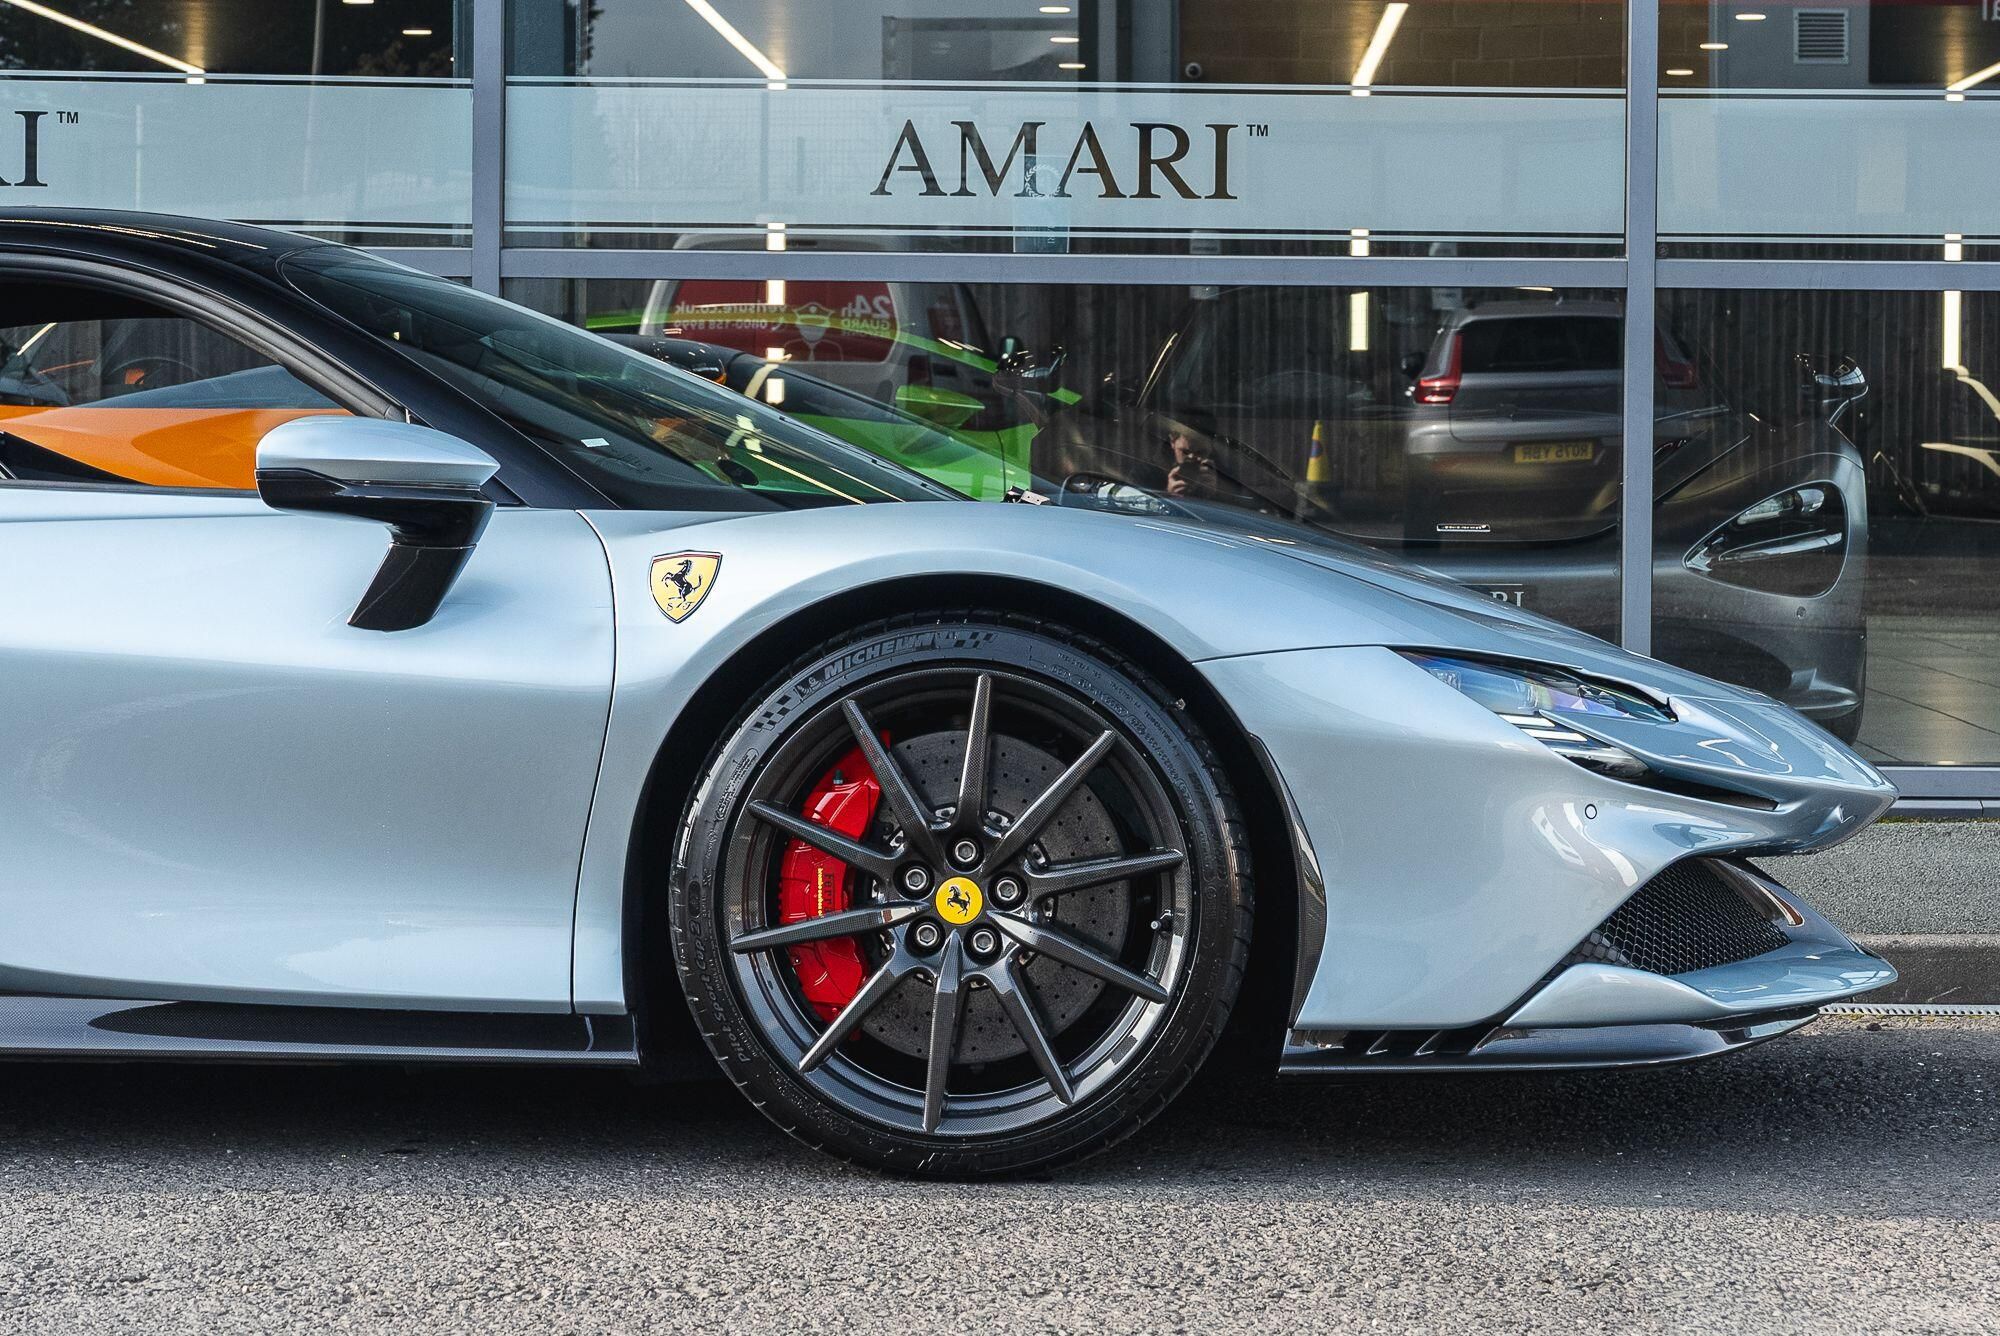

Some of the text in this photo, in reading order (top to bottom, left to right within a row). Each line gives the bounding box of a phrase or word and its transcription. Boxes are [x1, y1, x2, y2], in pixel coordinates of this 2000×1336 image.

[870, 119, 1238, 199] AMARI
[823, 633, 934, 680] MICHELIN
[689, 919, 701, 936] 2
[694, 937, 708, 971] Cup
[700, 972, 727, 1023] Sport
[721, 1024, 752, 1063] Pilot
